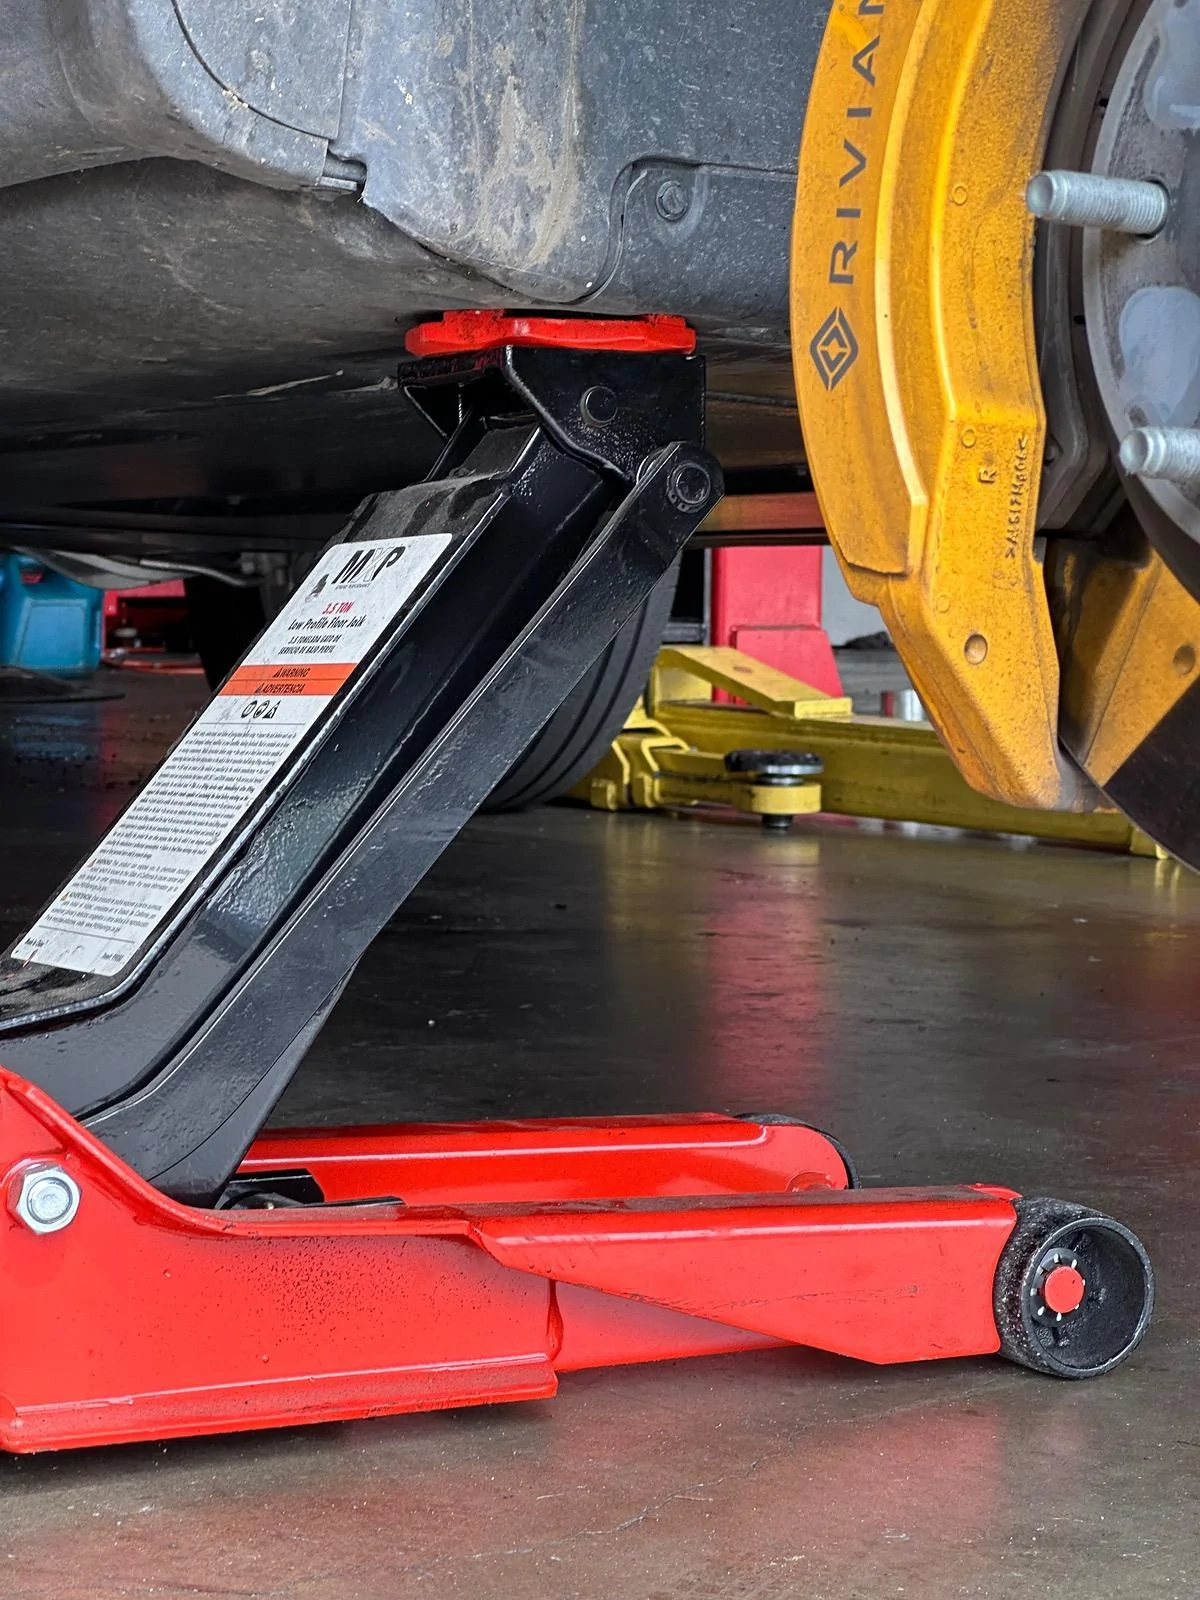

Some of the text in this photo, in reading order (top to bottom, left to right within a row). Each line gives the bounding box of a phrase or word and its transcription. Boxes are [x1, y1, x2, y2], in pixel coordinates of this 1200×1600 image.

[331, 546, 406, 584] MXP
[322, 601, 355, 614] 3.5 TON
[287, 618, 305, 630] Low
[303, 617, 329, 629] Profile
[328, 615, 349, 629] Floor
[279, 667, 311, 678] WARNING
[261, 683, 306, 694] ADVERTENCIA
